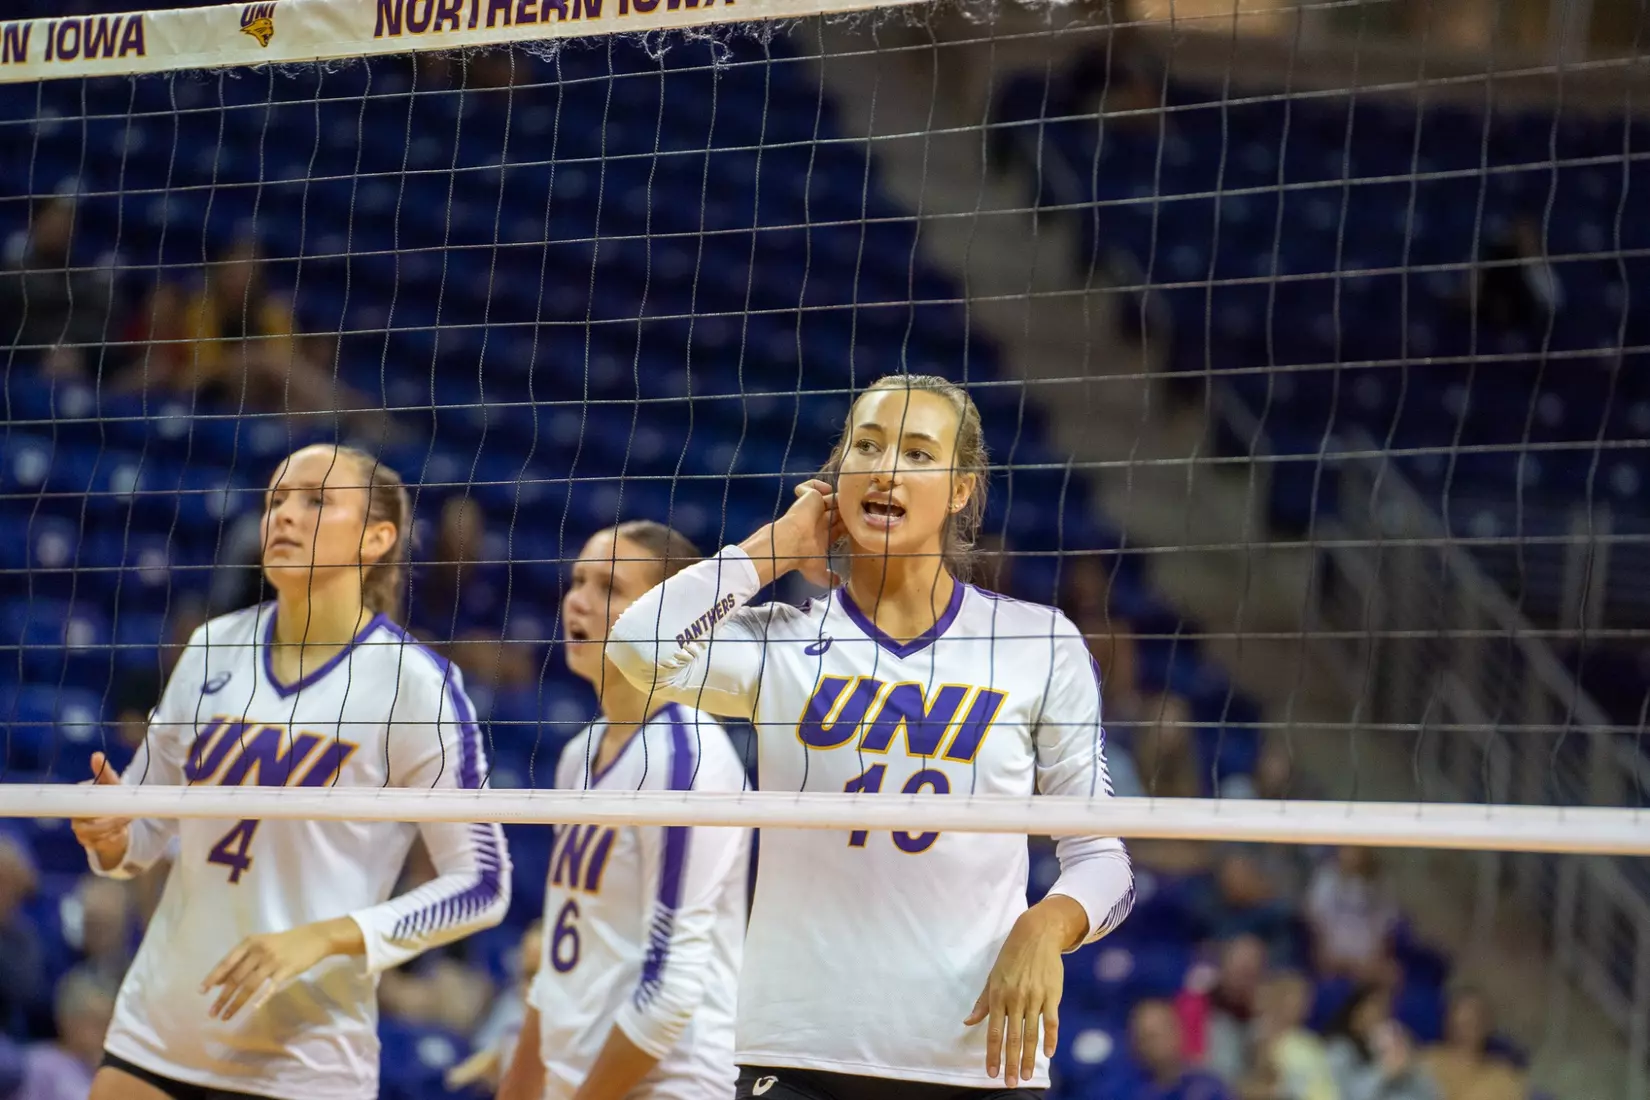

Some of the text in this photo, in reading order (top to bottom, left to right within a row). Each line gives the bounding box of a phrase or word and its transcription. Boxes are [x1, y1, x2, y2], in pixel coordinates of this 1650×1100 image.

[0, 14, 146, 64] N IOWA
[240, 2, 278, 27] UNI
[675, 593, 736, 650] PANTHERS
[182, 713, 361, 787] UNI
[795, 673, 1010, 764] UNI
[206, 818, 262, 885] 4
[551, 823, 618, 895] NI
[551, 896, 582, 975] 6
